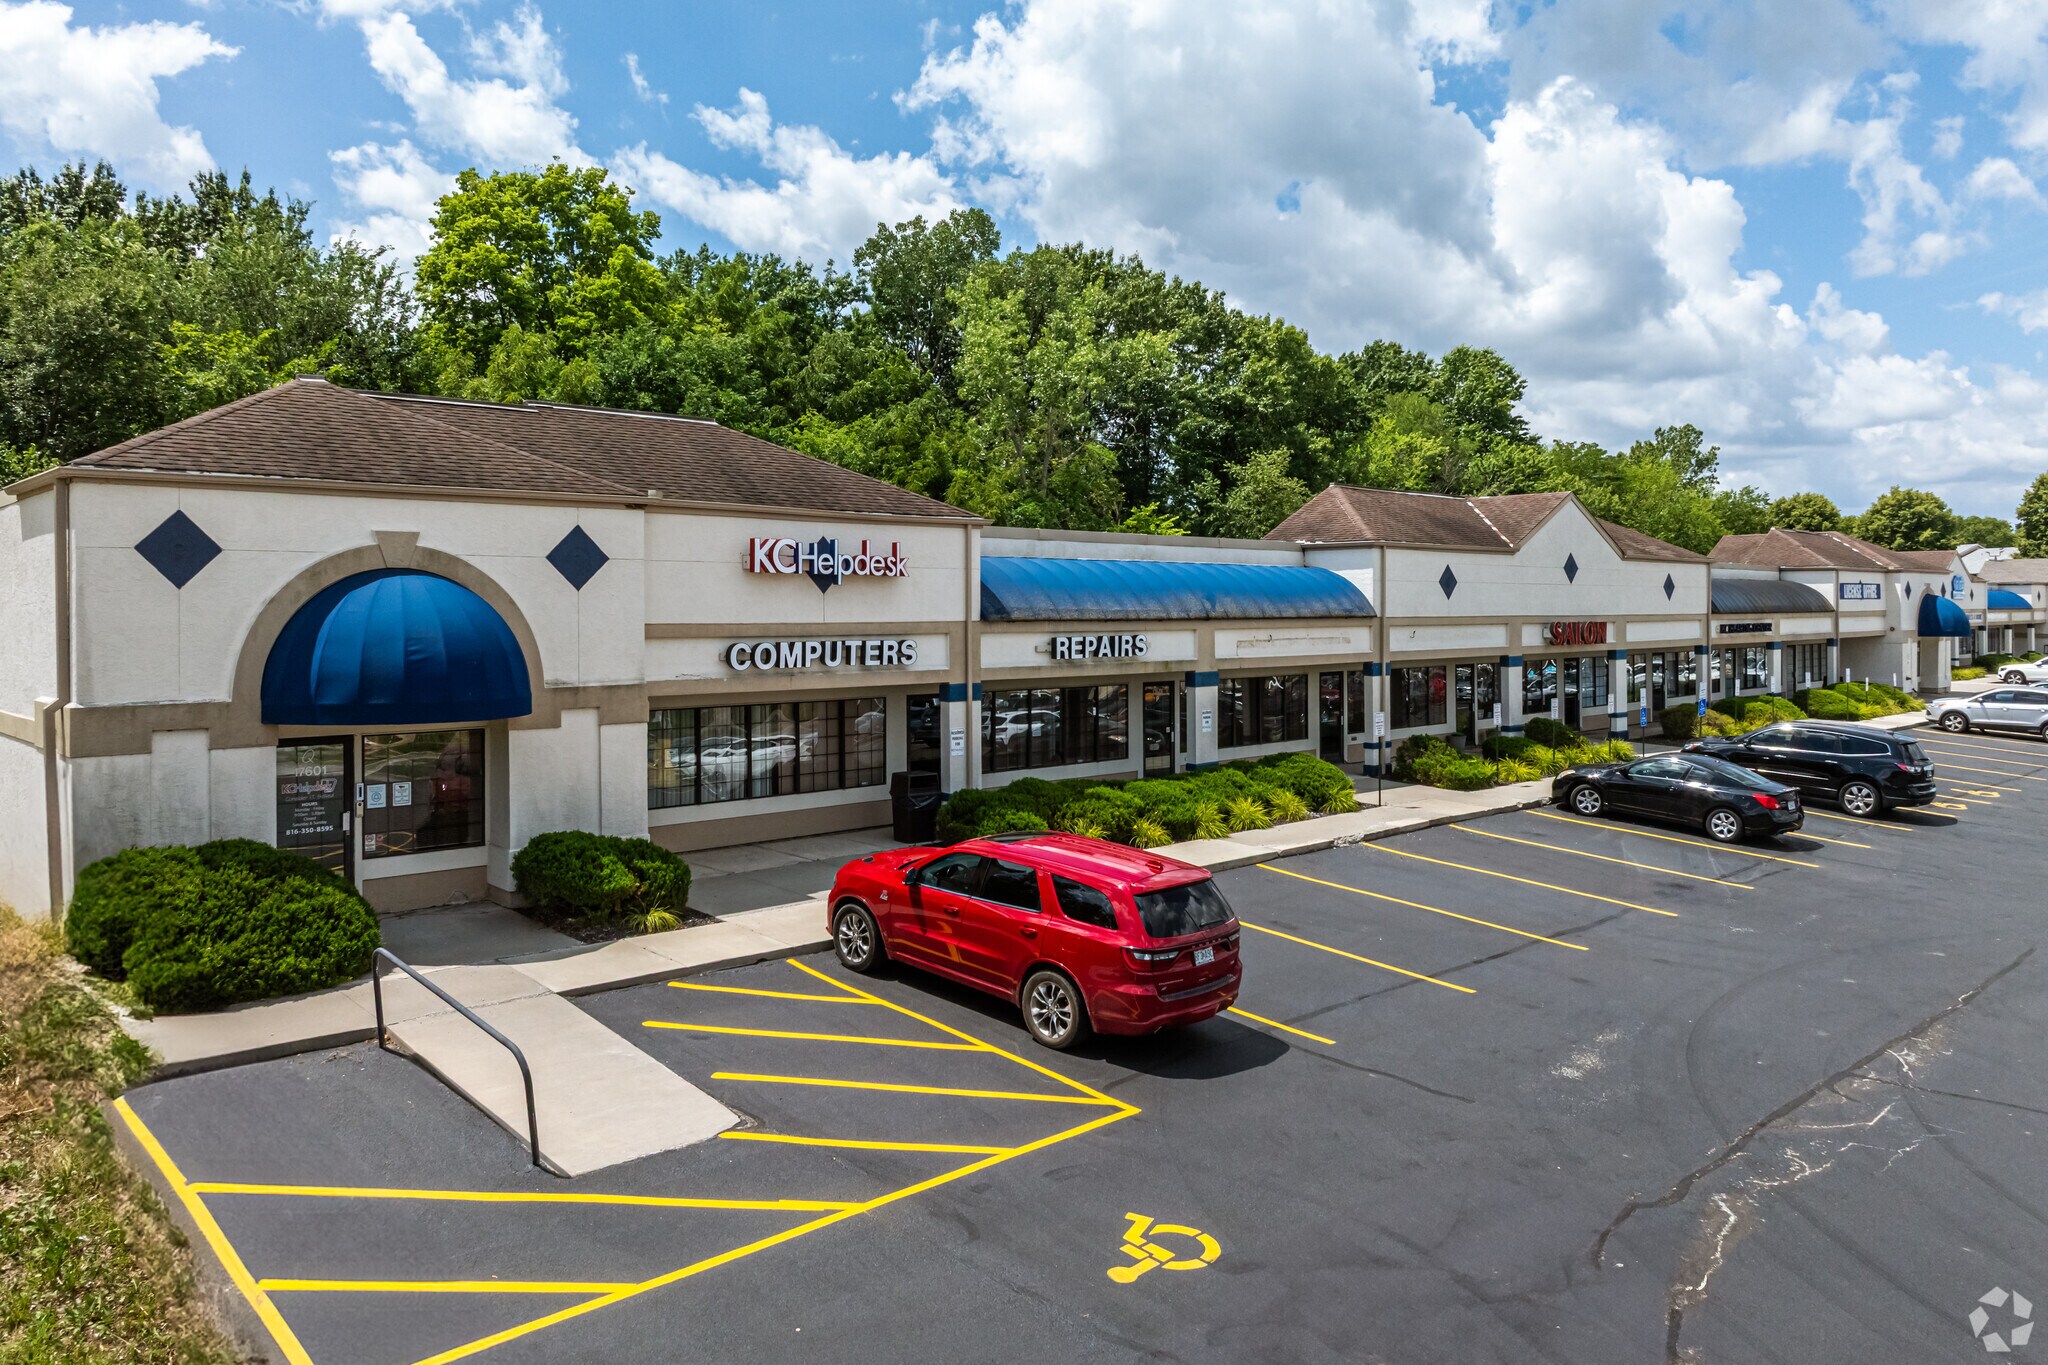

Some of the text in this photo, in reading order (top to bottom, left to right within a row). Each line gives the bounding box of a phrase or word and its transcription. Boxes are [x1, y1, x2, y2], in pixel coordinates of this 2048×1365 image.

[1843, 583, 1878, 599] LICENSE OFFICE
[1549, 621, 1608, 646] SALON
[726, 639, 918, 671] COMPUTERS
[1051, 634, 1148, 660] REPAIRS
[295, 765, 327, 777] 17601
[286, 825, 334, 835] 816-350-8595
